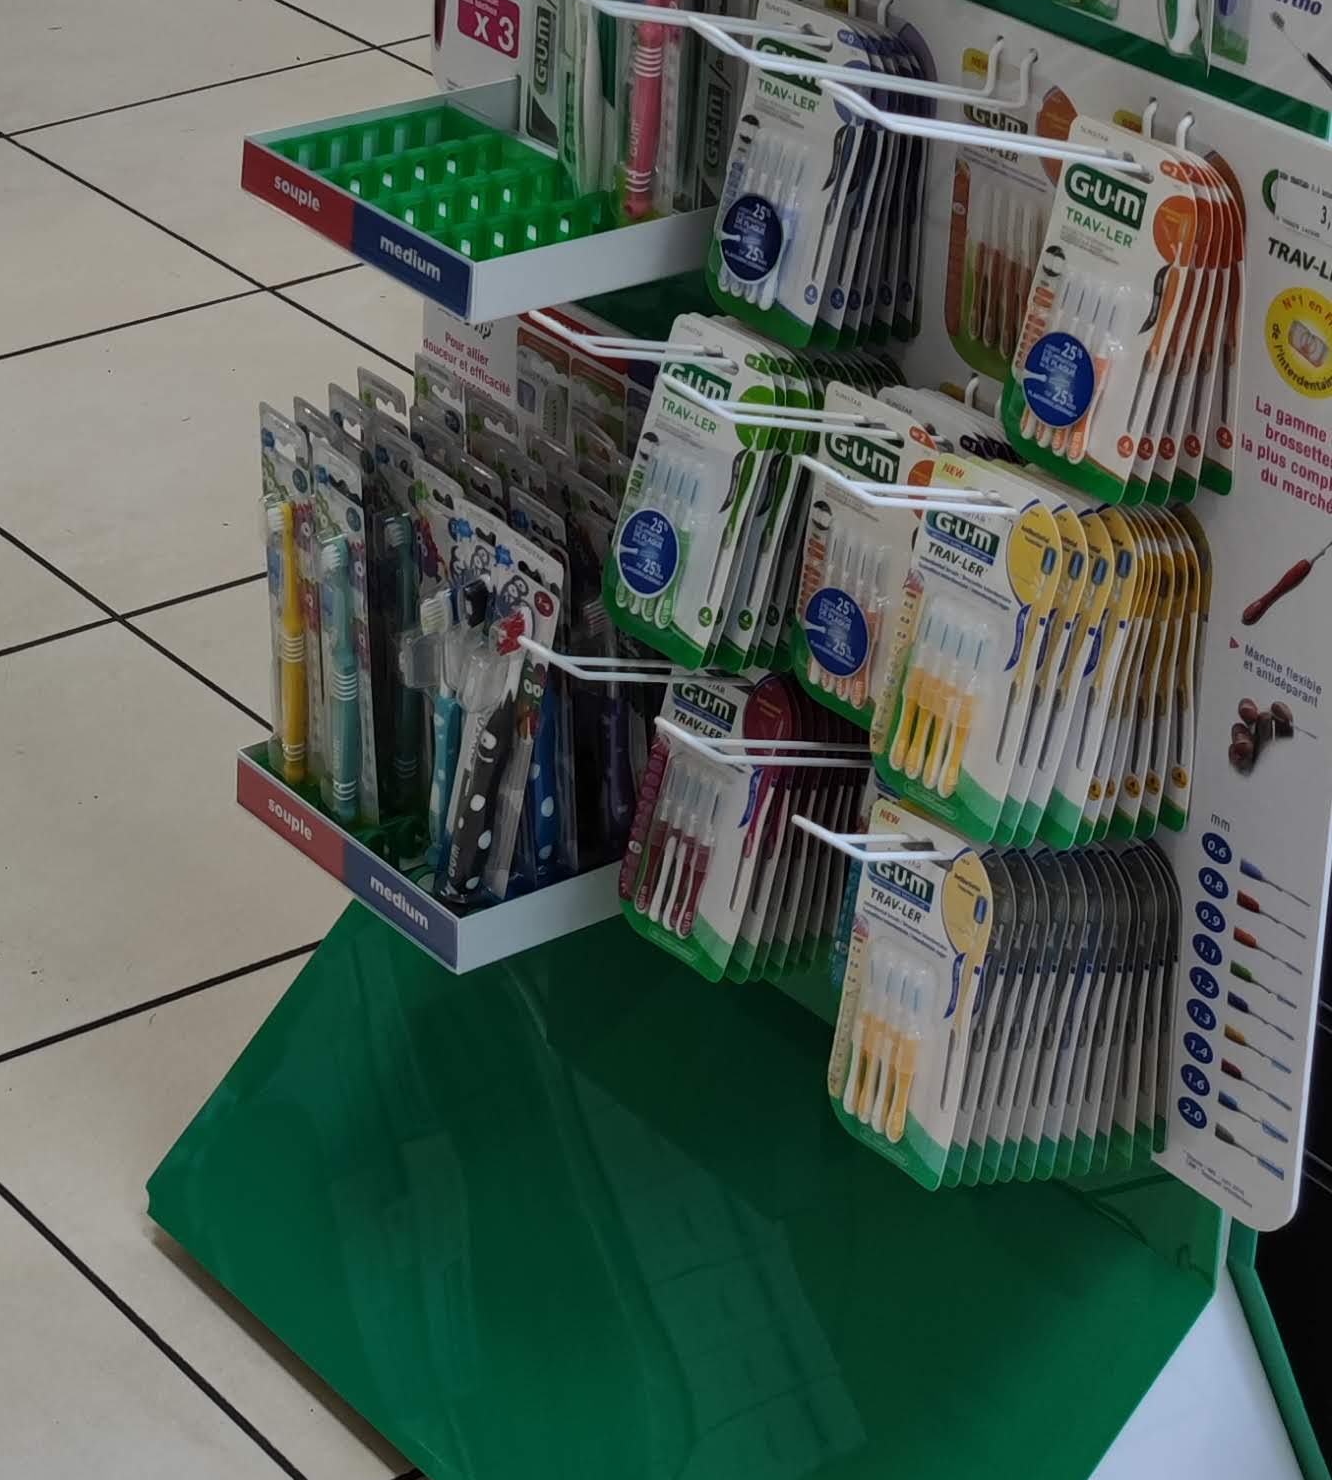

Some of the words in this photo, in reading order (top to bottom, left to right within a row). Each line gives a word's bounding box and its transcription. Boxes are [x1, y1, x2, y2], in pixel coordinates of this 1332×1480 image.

[497, 15, 515, 52] 3
[756, 77, 819, 114] TRAV-LER
[274, 172, 322, 212] souple
[379, 232, 442, 282] medium
[1066, 207, 1134, 249] TRAV-LER
[459, 359, 468, 372] et
[467, 346, 490, 367] allier
[661, 396, 717, 435] TRAV-LER
[1255, 394, 1272, 417] La
[1275, 406, 1328, 443] gamme
[1241, 434, 1253, 453] la
[1256, 440, 1287, 471] plus
[942, 462, 966, 480] NEW
[1260, 467, 1279, 487] du
[928, 540, 986, 578] TRAV-LER
[1244, 643, 1283, 674] Manche
[1286, 666, 1322, 695] flexible
[878, 808, 901, 826] NEW
[1210, 813, 1231, 833] mm
[1208, 838, 1227, 857] 0.6
[268, 794, 314, 841] souple
[370, 872, 430, 931] medium
[1204, 872, 1224, 893] 0.8
[869, 888, 922, 925] TRAV-LER
[1201, 906, 1221, 925] 0.9
[1199, 940, 1217, 960] 1.1
[1195, 973, 1215, 994] 1.2
[1193, 1006, 1213, 1025] 1.3
[1188, 1039, 1209, 1059] 1.4
[1185, 1072, 1205, 1091] 1.6
[1183, 1103, 1204, 1124] 2.0
